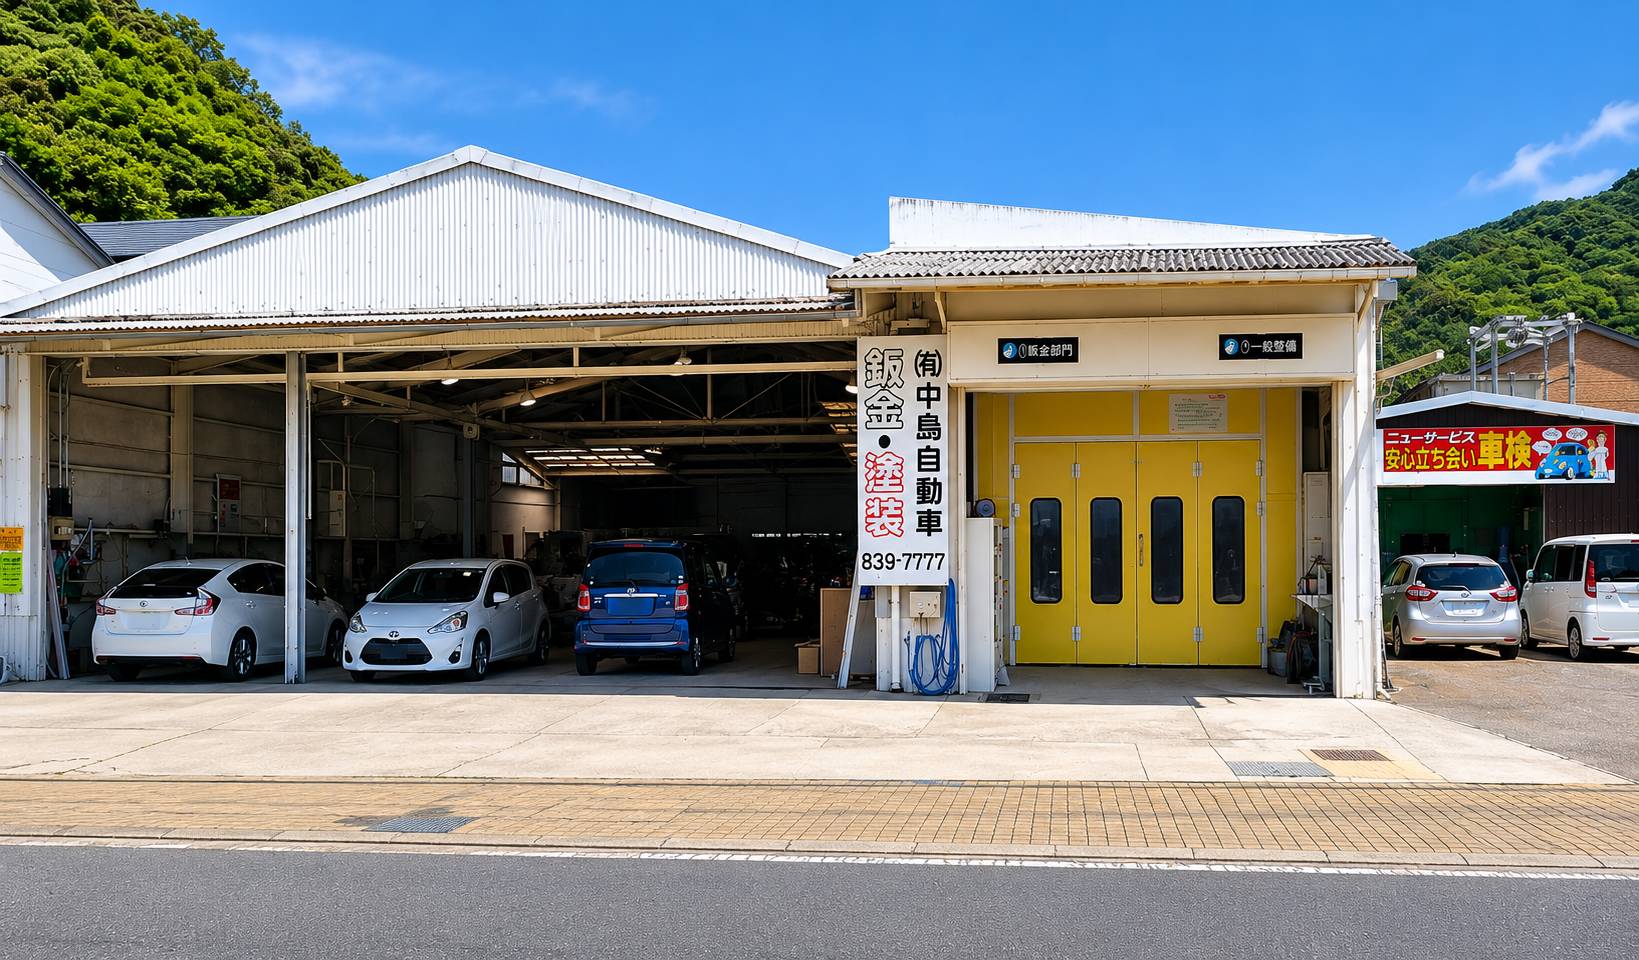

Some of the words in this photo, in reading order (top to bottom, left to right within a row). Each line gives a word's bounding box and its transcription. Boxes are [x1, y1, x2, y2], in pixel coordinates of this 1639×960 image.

[1386, 430, 1475, 444] ニューサービス
[1385, 446, 1476, 470] 安心立ち会い
[1478, 430, 1532, 470] 車検
[861, 552, 945, 570] 839-7777
